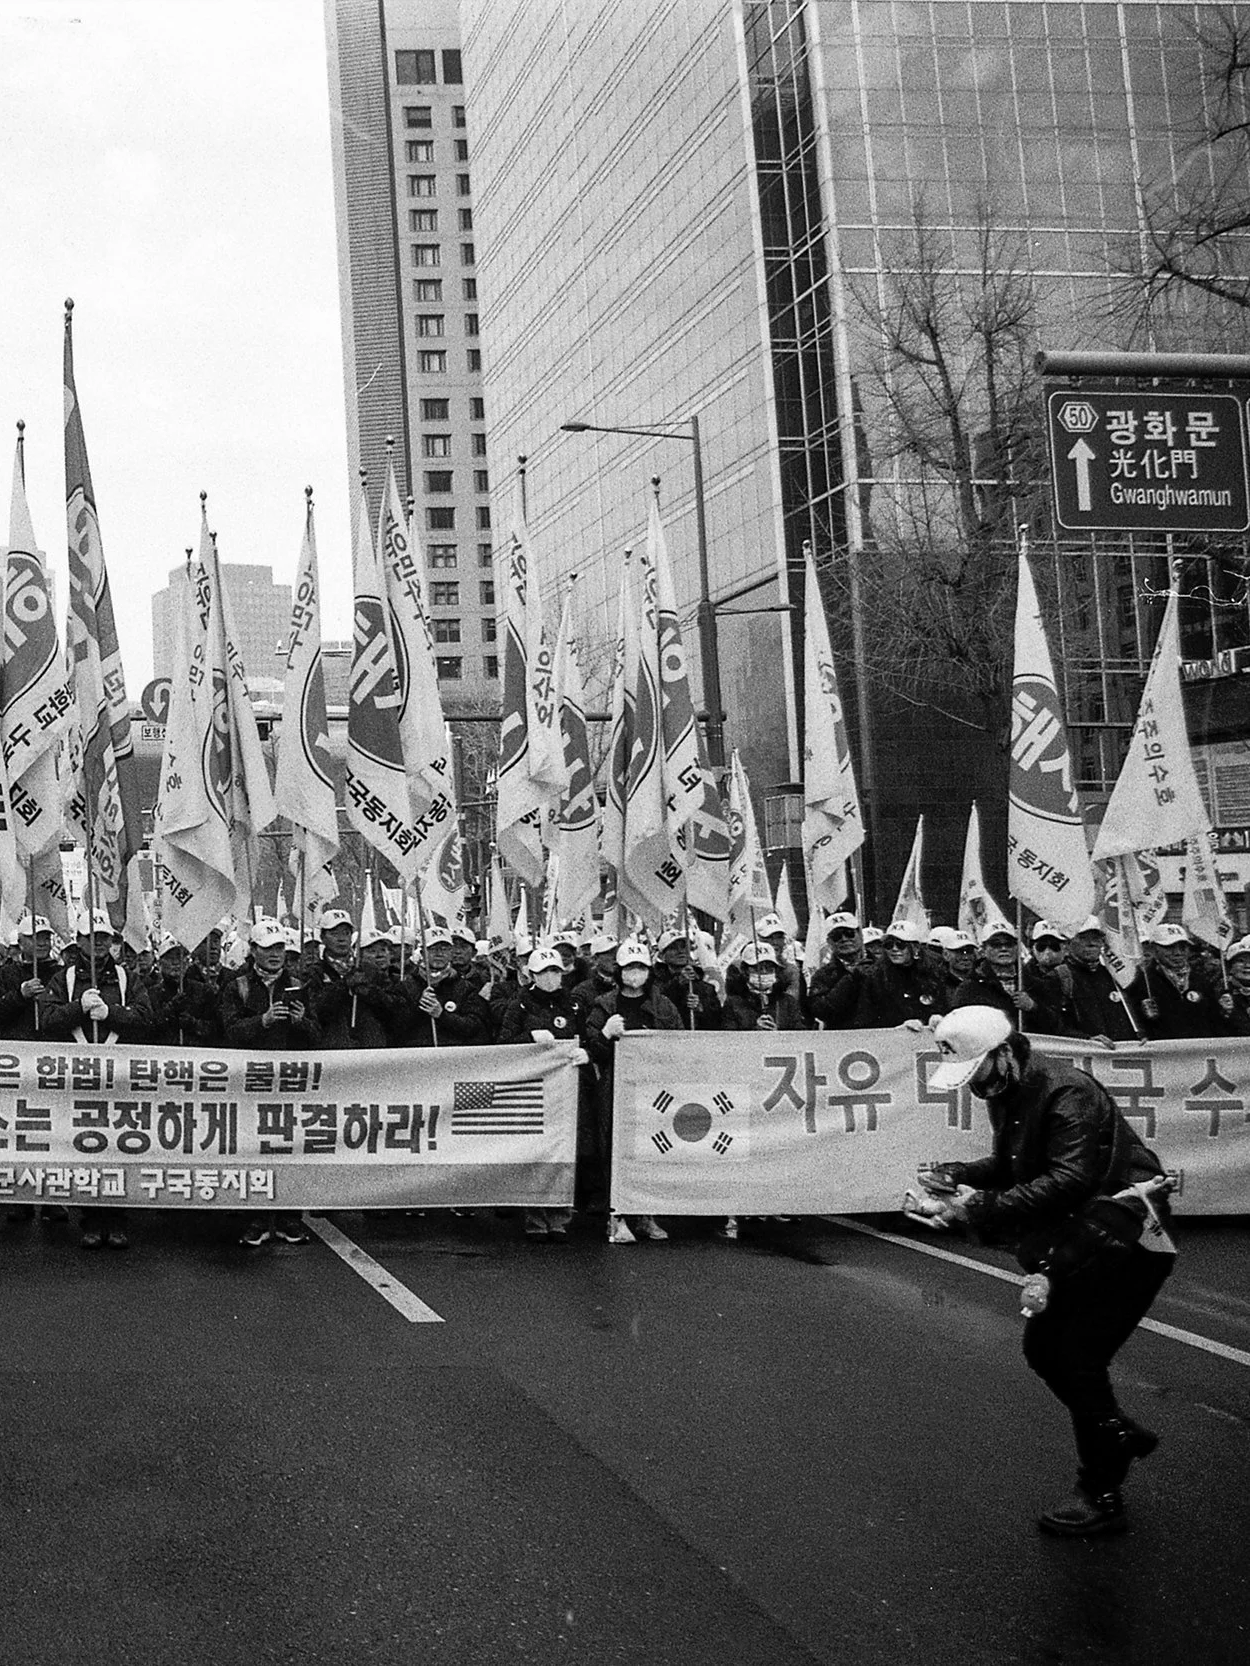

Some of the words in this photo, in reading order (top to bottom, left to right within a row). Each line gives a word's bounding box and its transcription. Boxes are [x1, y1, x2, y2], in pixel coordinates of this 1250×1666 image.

[1069, 407, 1087, 425] 50
[1106, 410, 1220, 447] 광화문
[1109, 449, 1198, 479] 光化門
[1111, 482, 1231, 511] Gwanghwamun
[36, 1055, 115, 1092] 합법!
[129, 1059, 229, 1093] 탄핵은
[244, 1060, 323, 1093] 불법!
[763, 1051, 892, 1134] 자유
[915, 1051, 1165, 1139] 대국
[1183, 1057, 1250, 1139] 수
[72, 1099, 239, 1155] 공정하게
[256, 1103, 442, 1155] 판결하라!
[139, 1168, 276, 1201] 구국동지회
